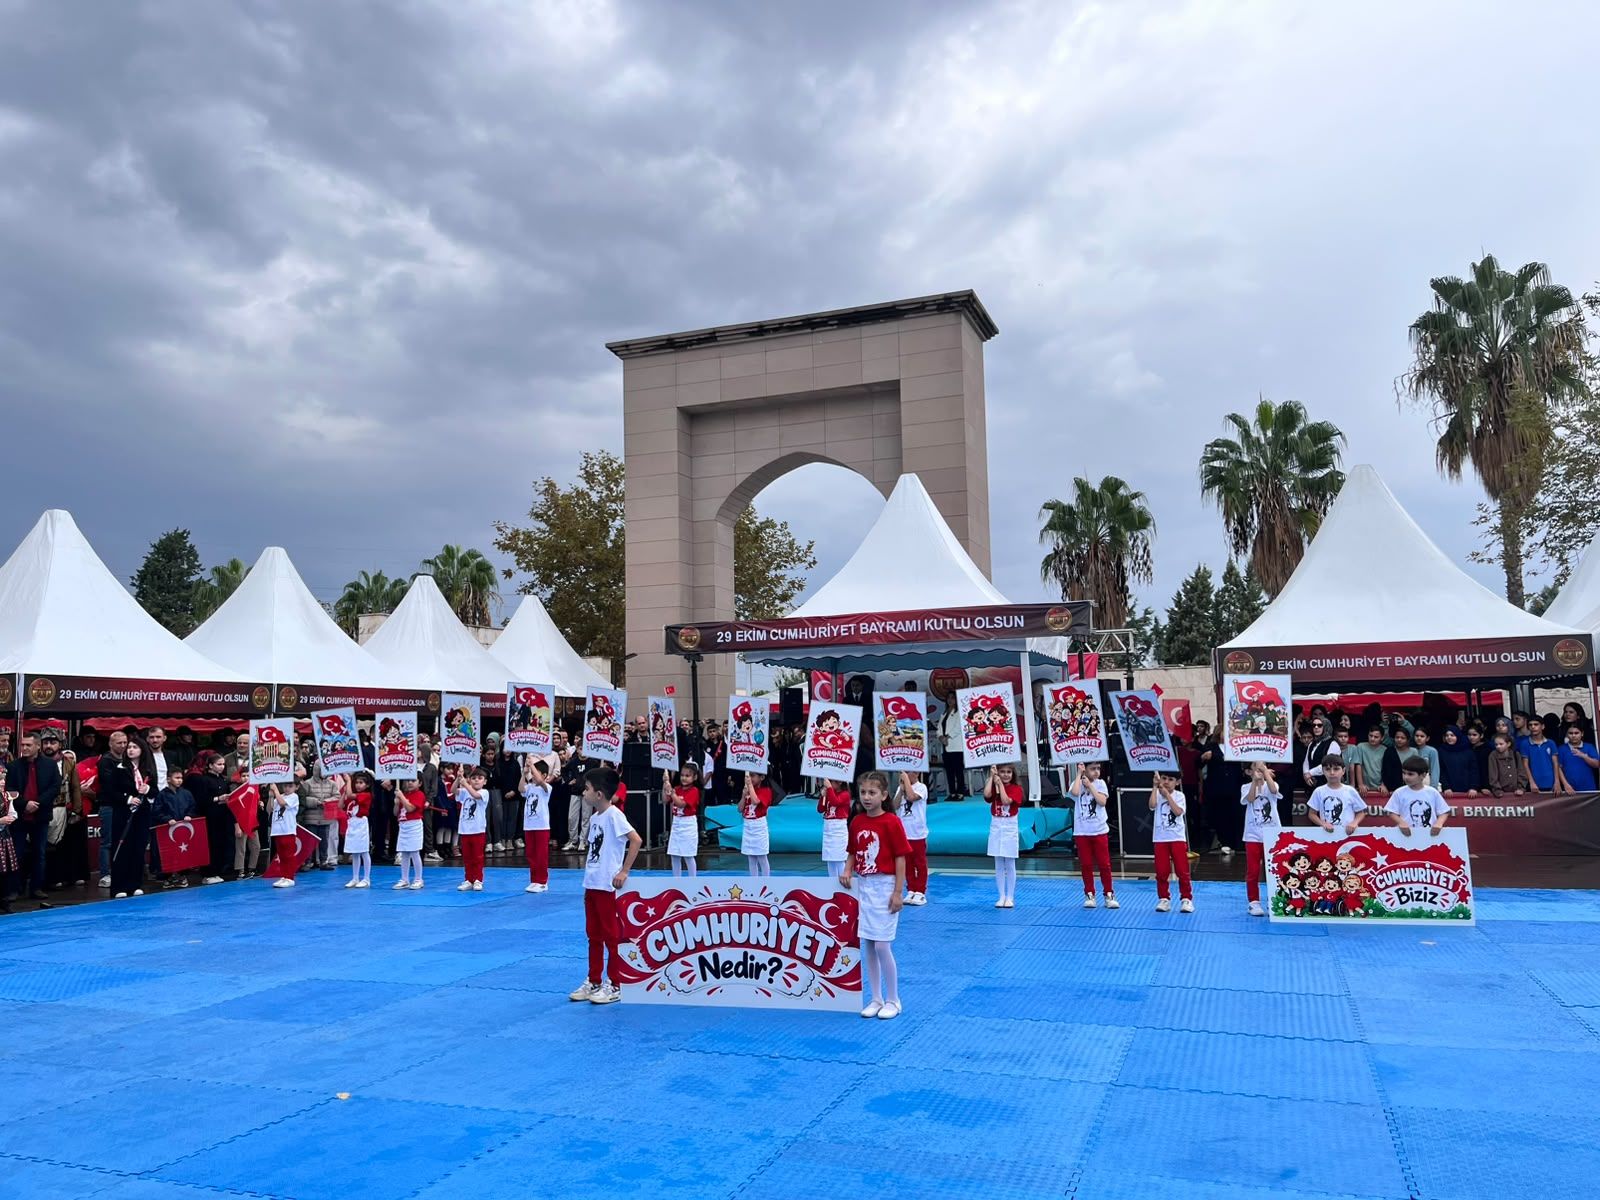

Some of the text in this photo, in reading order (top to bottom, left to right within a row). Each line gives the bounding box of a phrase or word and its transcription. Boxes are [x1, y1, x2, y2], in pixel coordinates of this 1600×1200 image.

[716, 615, 1025, 643] 29 EKİM CUMHURİYET BAYRAMI KUTLU OLSUN
[1259, 651, 1546, 671] 29 EKİM CUMHURİYET BAYRAMI KUTLU OLSUN
[59, 688, 249, 703] 29 EKİM CUMHURİYET BAYRAMI KUTLU OLSUN
[299, 695, 426, 707] 29 EKİM CUMHURİYET BAYRAMI KUTLU OLSUN
[445, 738, 477, 748] CUMHURİYET
[509, 730, 549, 743] CUMHURİYET
[587, 732, 619, 746] CUMHURİYET
[969, 732, 1012, 748] CUMHURİYET
[1231, 735, 1287, 748] CUMHURİYET
[731, 743, 764, 757] CUMHURİYET
[1056, 736, 1101, 751] CUMHURİYET
[810, 749, 851, 762] CUMHURİYET
[881, 747, 923, 758] CUMHURİYET
[1131, 745, 1169, 758] CUMHURİYET
[379, 753, 414, 765] CUMHURİYET
[253, 763, 289, 774] CUMHURİYET
[1291, 806, 1308, 817] 29
[1463, 806, 1535, 817] BAYRAMI
[87, 826, 102, 838] EK
[1375, 862, 1458, 890] CUMHURİYET
[1394, 886, 1439, 905] Biziz
[645, 904, 835, 967] CUMHURİYET
[698, 950, 783, 984] Nedir?
